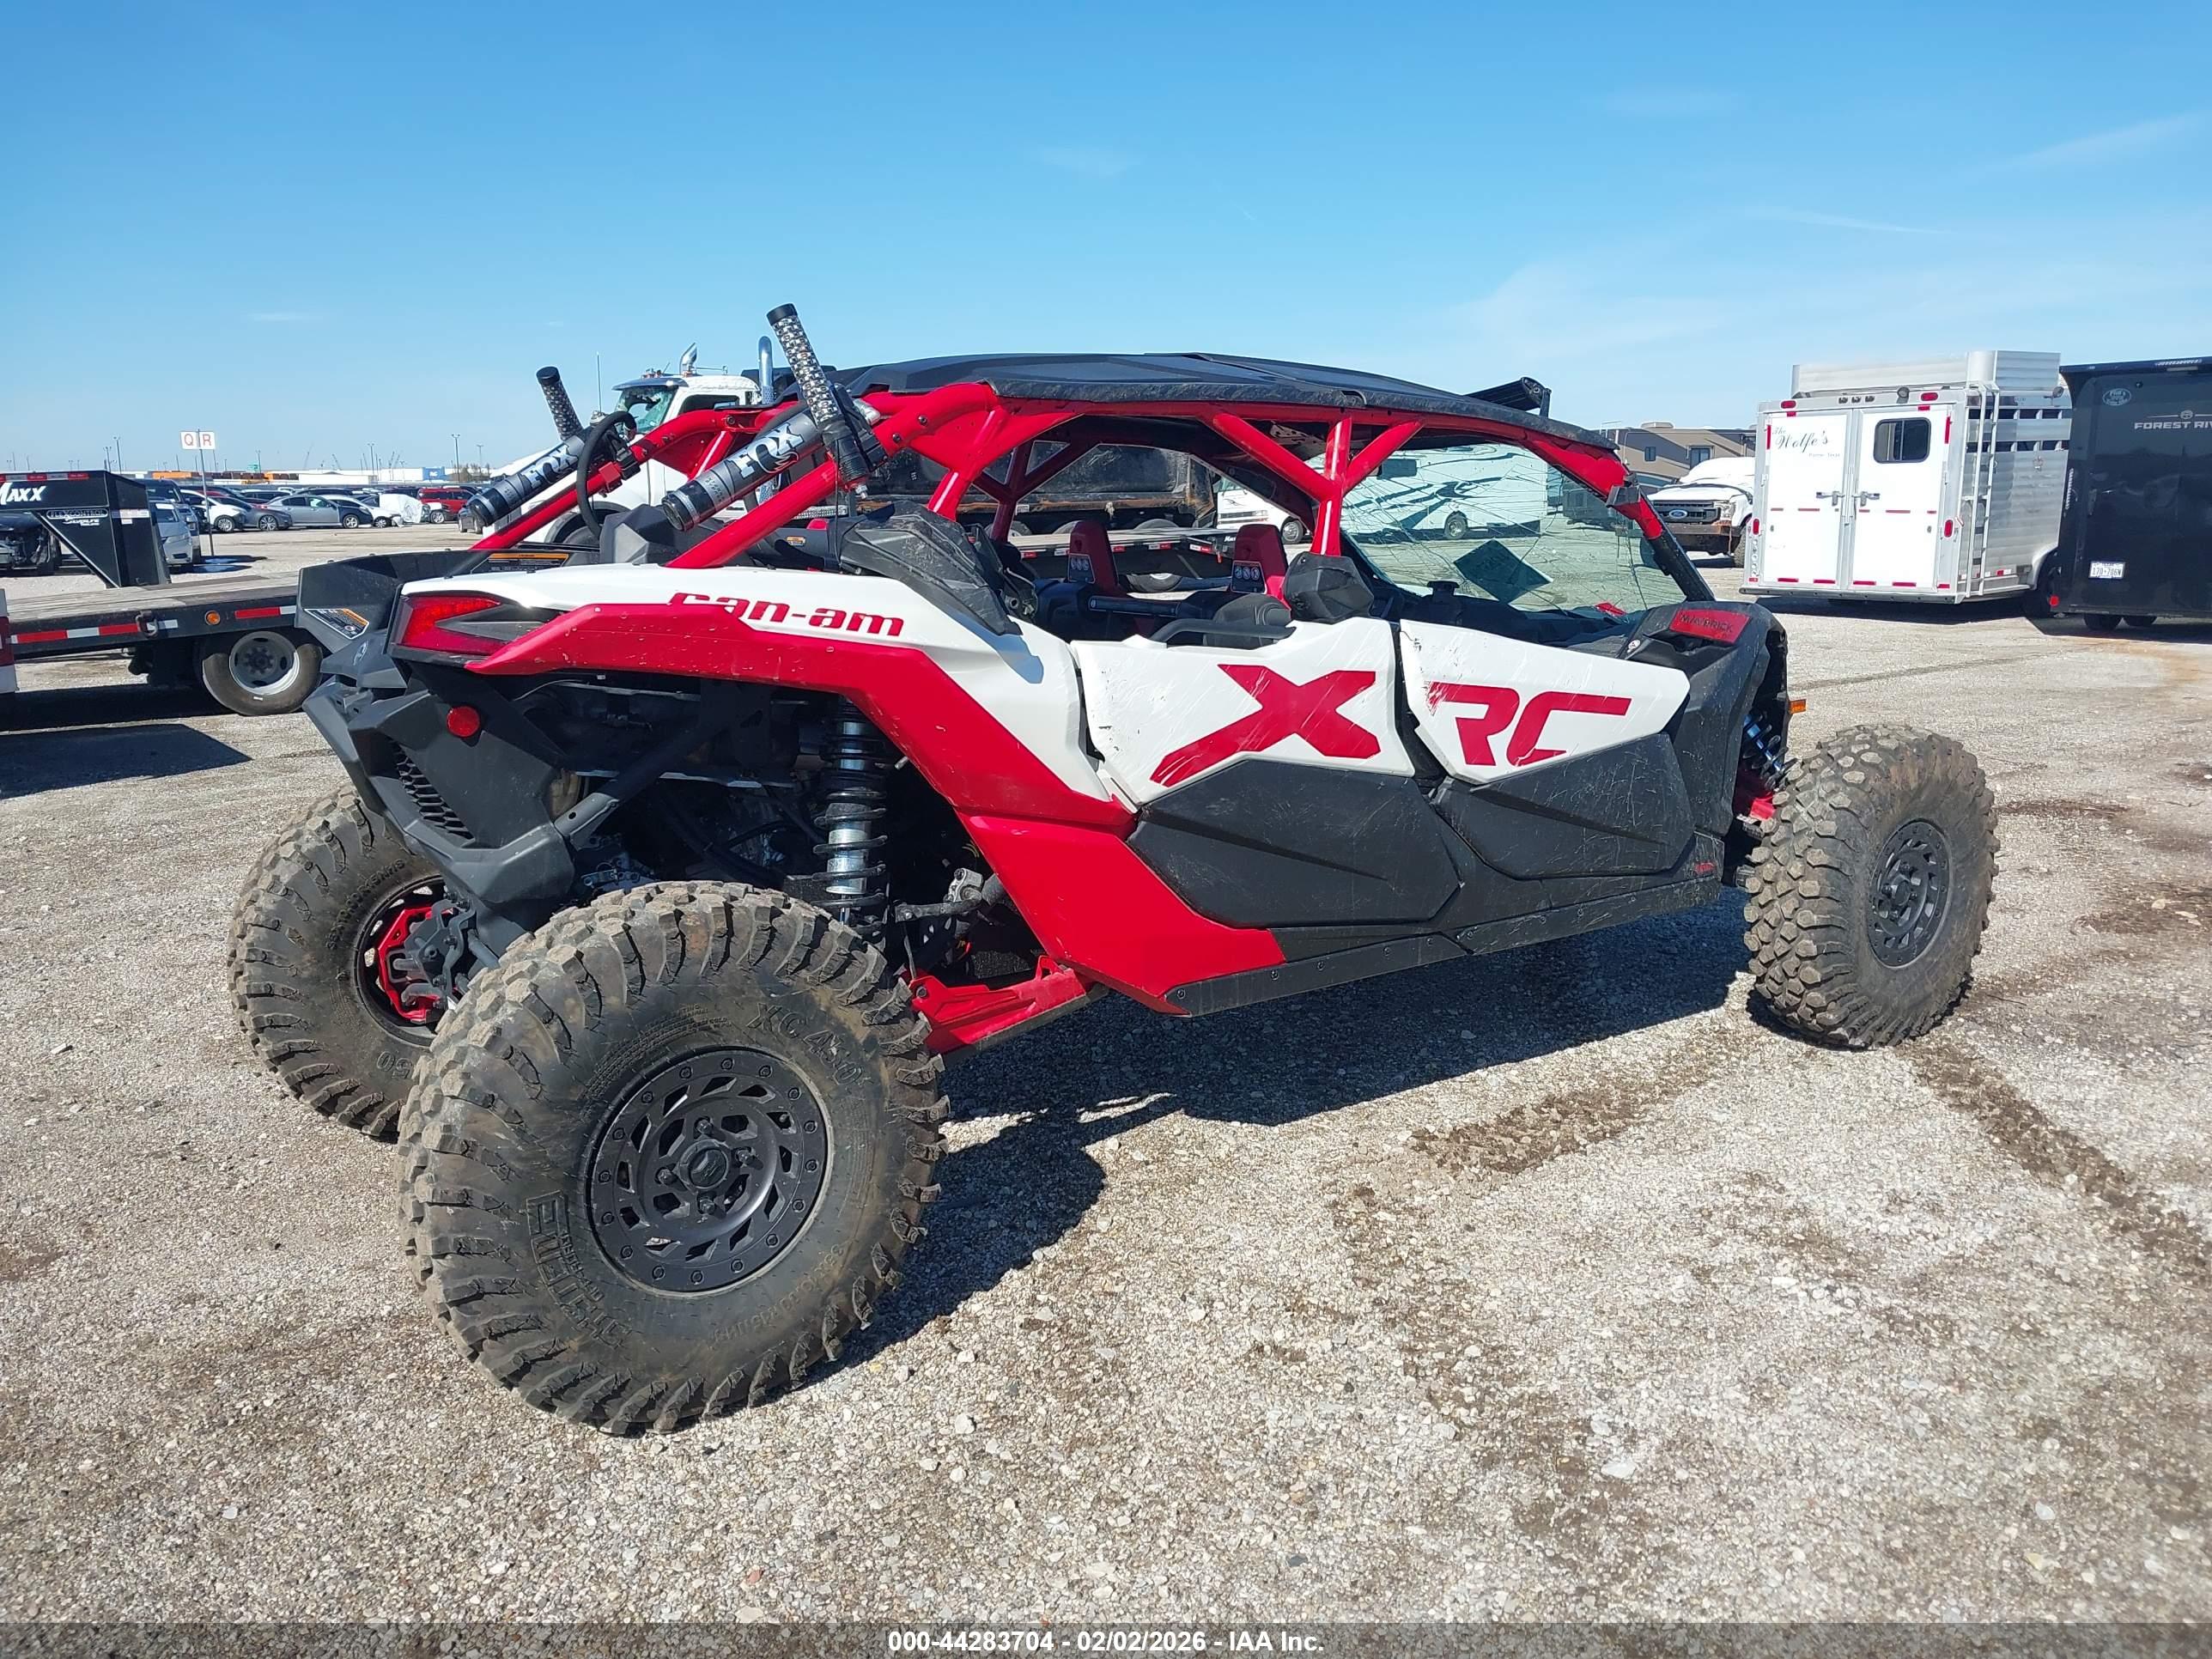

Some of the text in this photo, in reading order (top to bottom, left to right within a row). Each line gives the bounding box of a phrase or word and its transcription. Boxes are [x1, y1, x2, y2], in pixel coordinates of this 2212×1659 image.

[184, 433, 194, 446] Q
[202, 434, 212, 446] R
[1775, 430, 1828, 453] Wolfe's
[2134, 421, 2191, 429] FOREST
[520, 444, 580, 489] FOX
[727, 422, 805, 478] FOX
[668, 592, 904, 636] can-am
[1150, 664, 1632, 787] X RC
